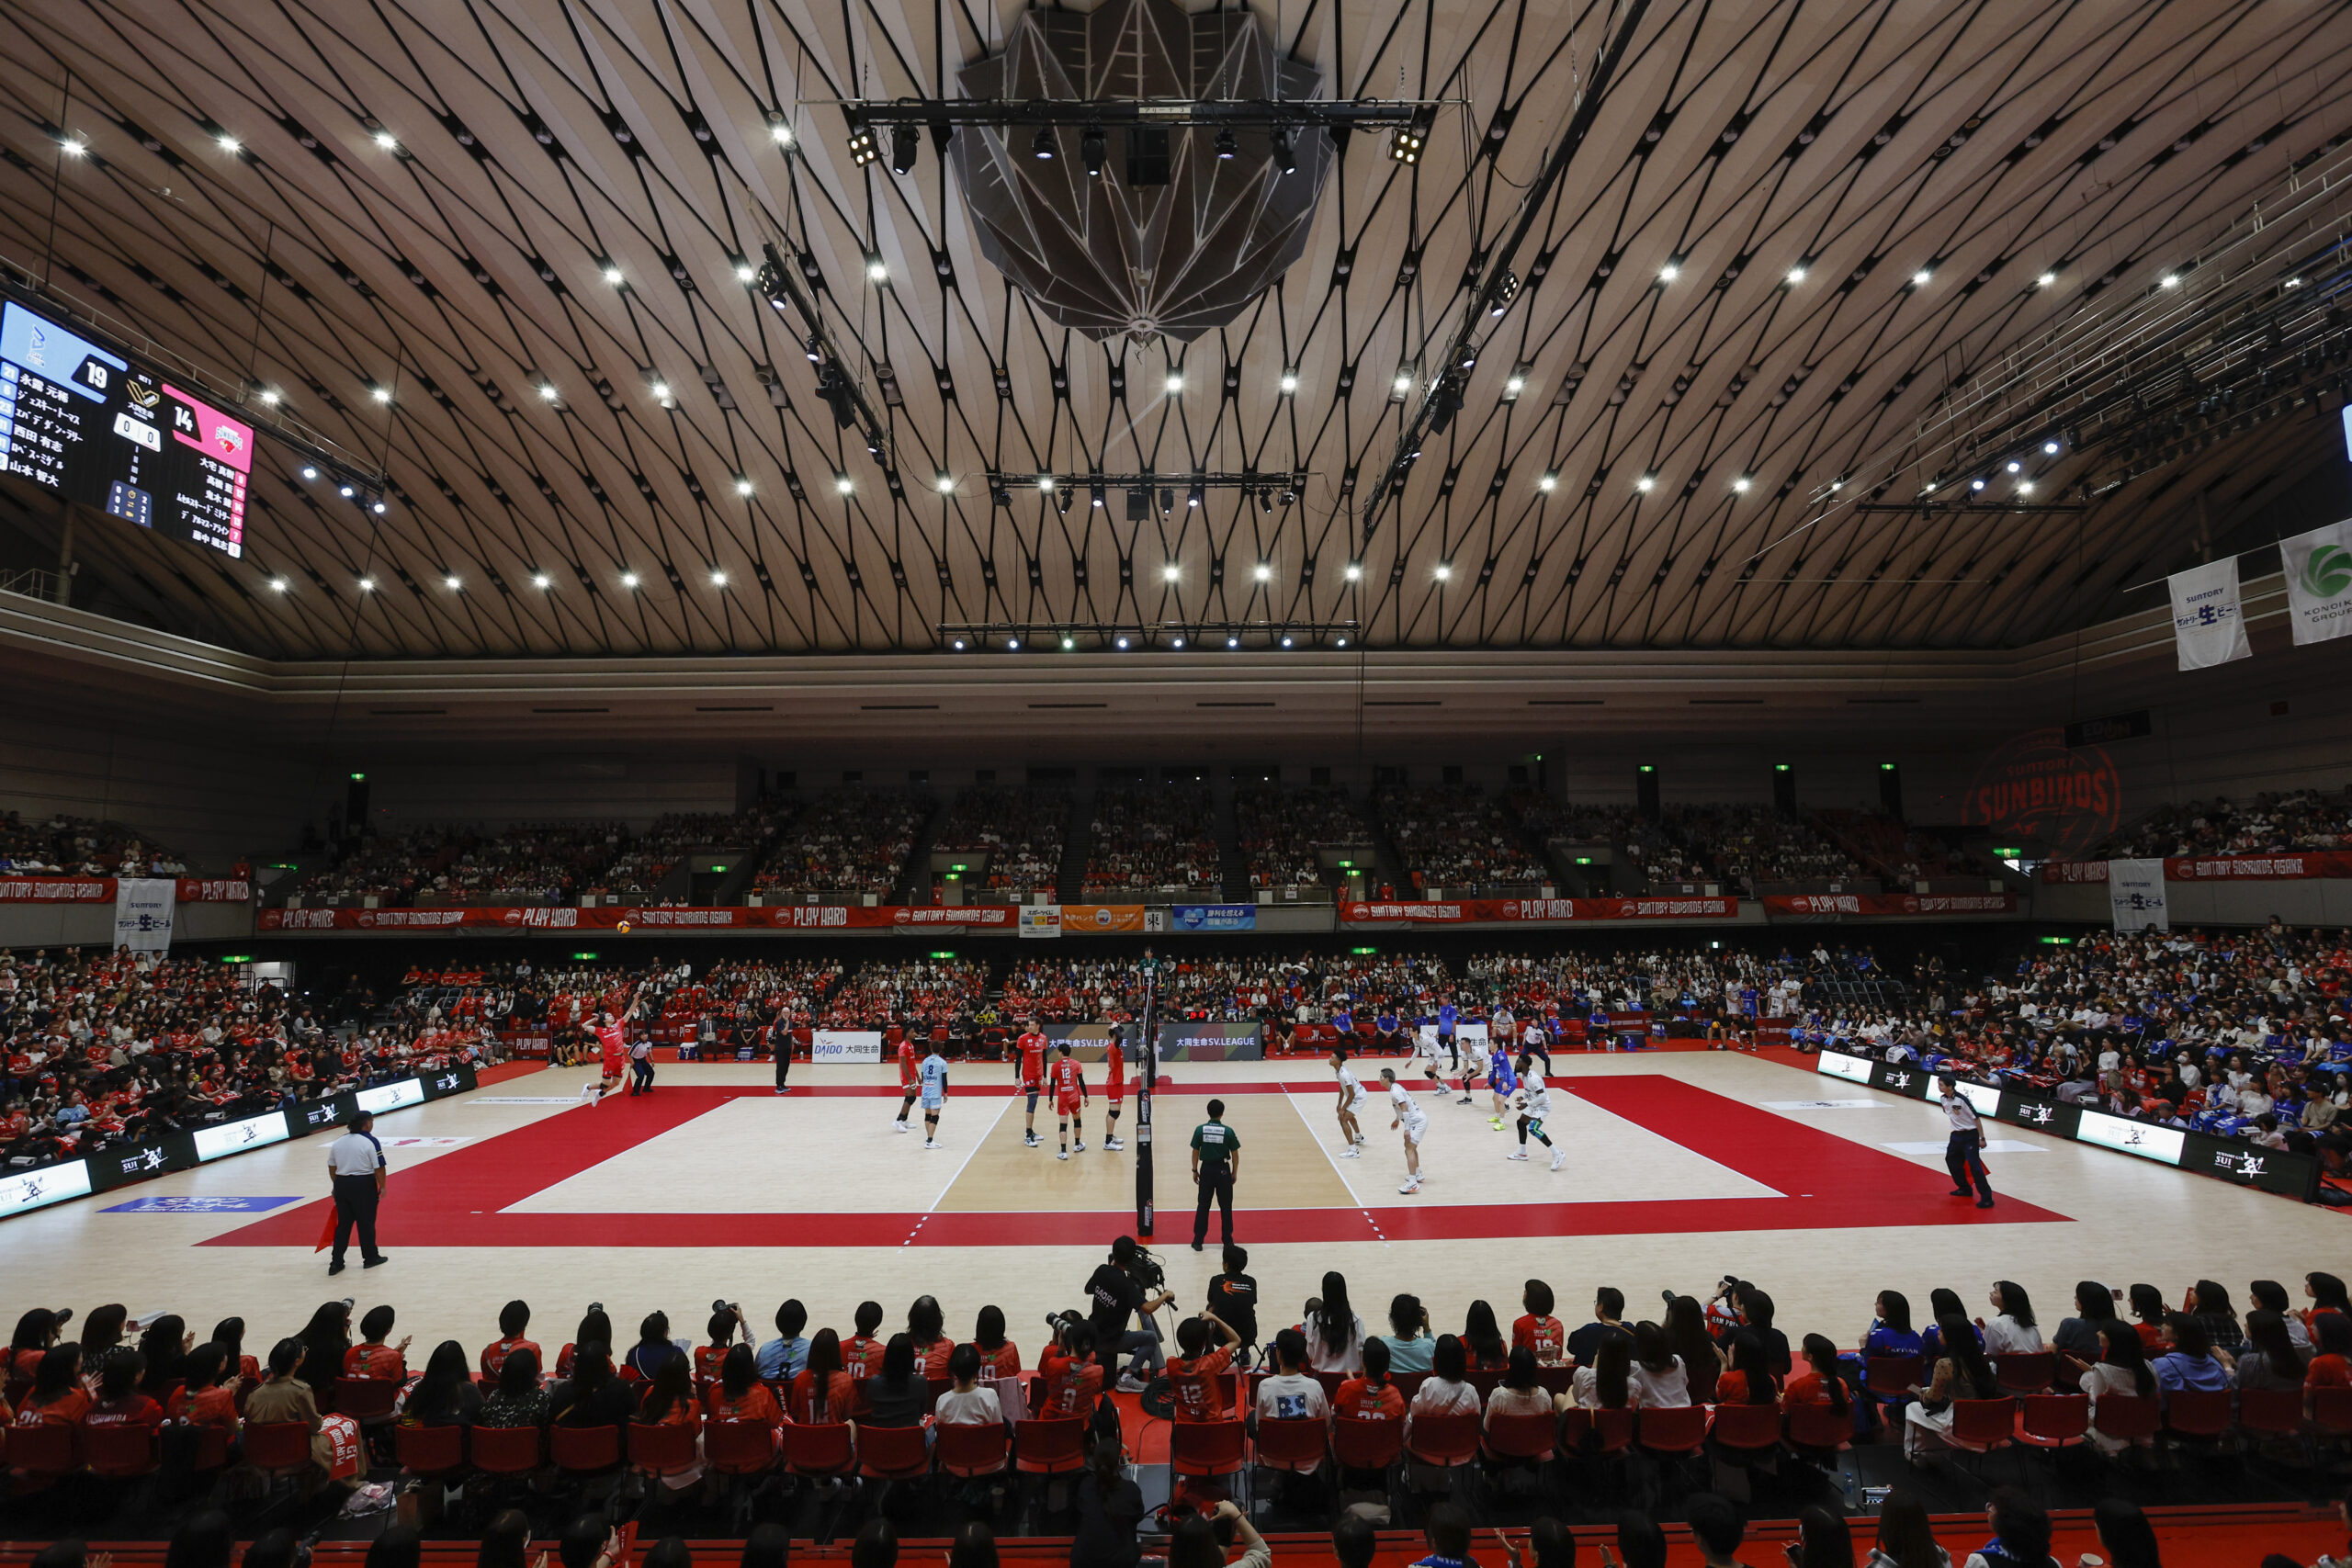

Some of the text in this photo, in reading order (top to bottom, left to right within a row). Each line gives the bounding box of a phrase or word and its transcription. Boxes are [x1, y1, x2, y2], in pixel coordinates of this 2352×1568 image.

[87, 362, 108, 389] 19
[124, 421, 130, 433] 0
[175, 406, 194, 432] 14
[14, 423, 38, 444] 西田
[40, 435, 63, 453] 有志
[147, 432, 154, 443] 0
[9, 460, 34, 477] 山本
[199, 457, 217, 472] 大宅
[141, 496, 148, 504] 2
[233, 531, 240, 541] 7
[2186, 588, 2224, 604] SUNTORY
[2177, 604, 2238, 626] サントリー生ビー
[2007, 756, 2075, 776] SUNTORY
[1978, 766, 2109, 827] SUNBIRDS
[201, 881, 225, 900] PLAY
[1521, 900, 1547, 919] PLAY
[1808, 897, 1834, 912] PLAY
[282, 908, 309, 928] PLAY
[522, 908, 549, 927] PLAY
[793, 908, 820, 926] PLAY
[814, 1043, 879, 1057] DAIDO 大同生命
[1048, 1038, 1128, 1047] 大同生命SV.LEAE
[1176, 1037, 1255, 1047] 大同生命SV.LEAGUE
[928, 1065, 934, 1075] 8
[1061, 1068, 1071, 1078] 12
[122, 1160, 139, 1171] SUI
[2215, 1156, 2233, 1166] SUI
[1095, 1286, 1118, 1308] GAORA
[847, 1362, 866, 1379] 10
[1061, 1388, 1077, 1413] 9
[1181, 1384, 1204, 1404] 12
